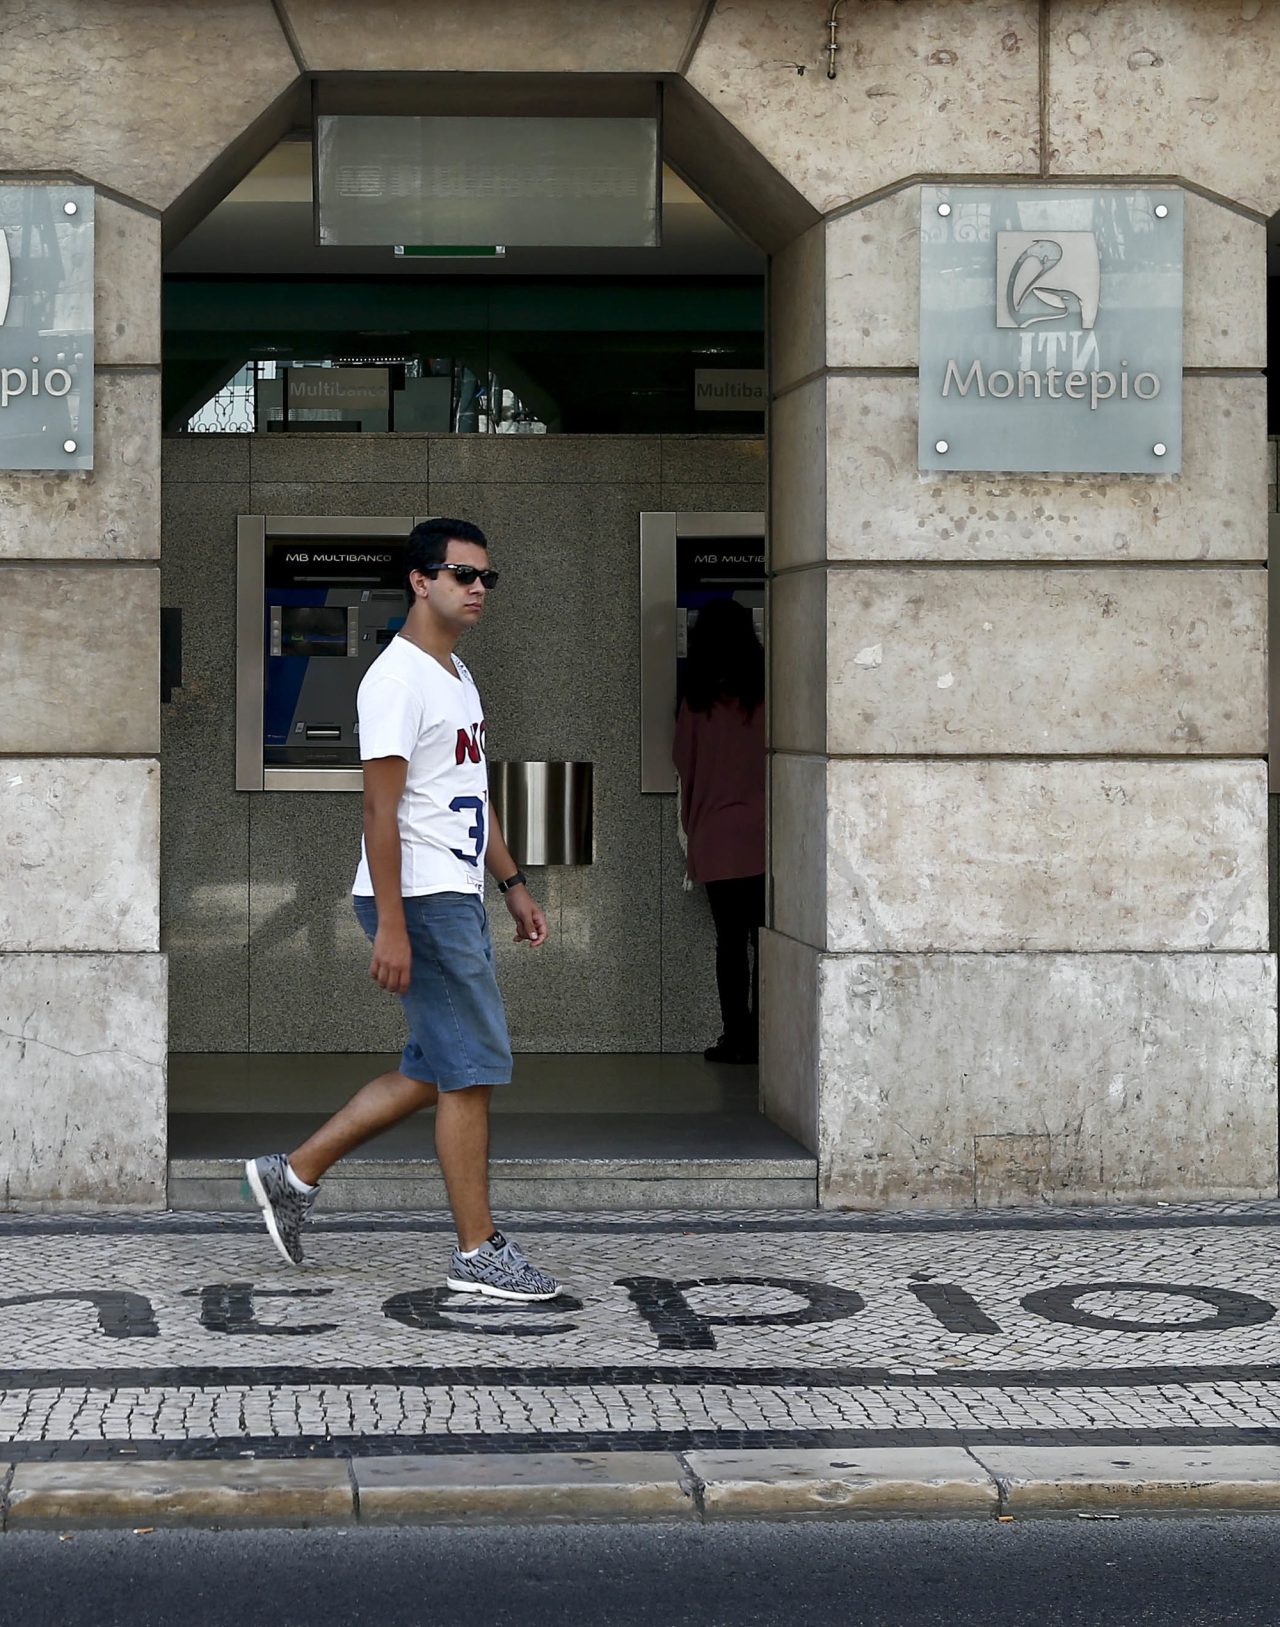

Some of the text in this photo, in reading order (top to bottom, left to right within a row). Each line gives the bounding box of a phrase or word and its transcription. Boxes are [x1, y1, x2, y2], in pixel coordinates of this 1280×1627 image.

[289, 381, 388, 398] Multibanco
[941, 359, 1161, 410] Montepio
[285, 554, 392, 562] MB MULTIBANCO
[694, 554, 718, 563] MB
